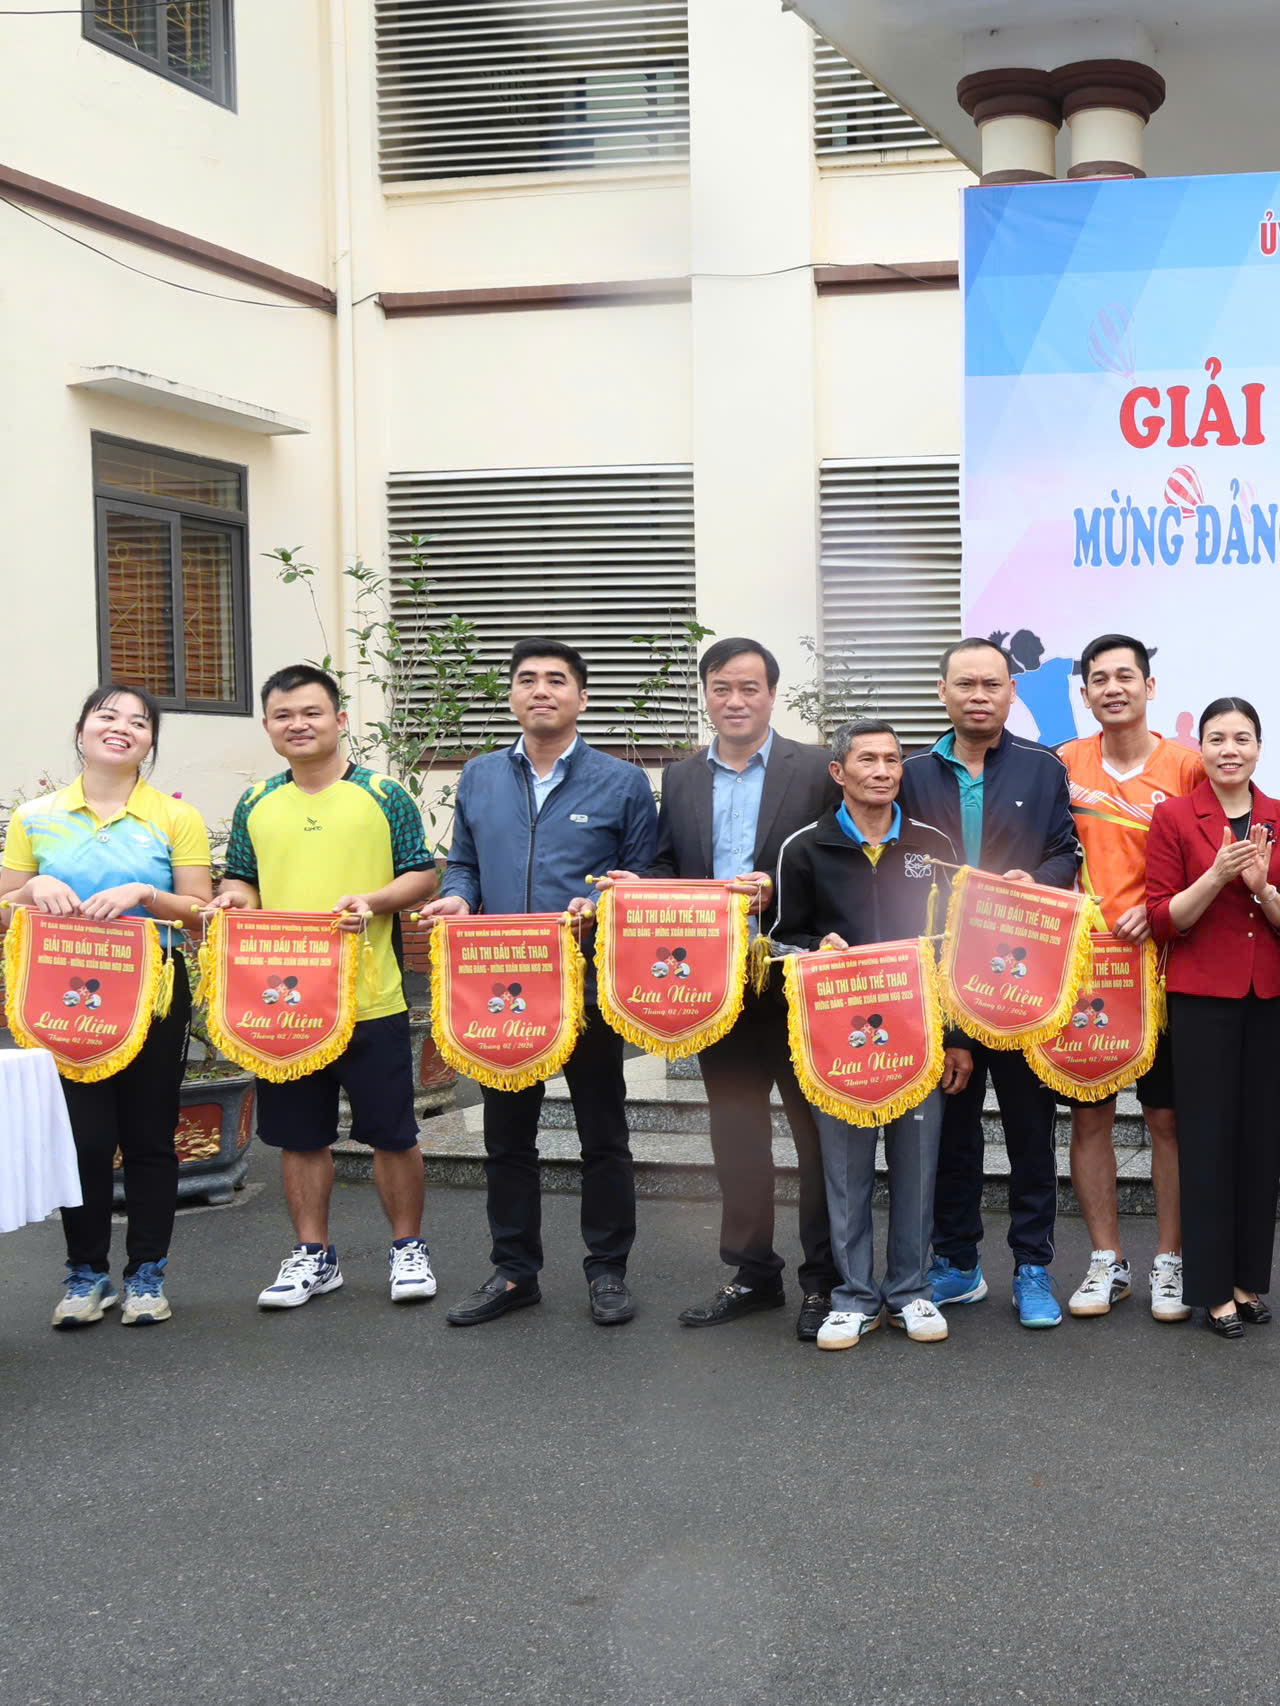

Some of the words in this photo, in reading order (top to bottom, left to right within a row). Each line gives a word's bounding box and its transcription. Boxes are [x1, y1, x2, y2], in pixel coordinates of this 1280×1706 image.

[1119, 357, 1265, 448] GIẢI
[1073, 488, 1184, 567] MỪNG
[627, 985, 662, 1003] Lưu
[668, 985, 712, 1006] Niệm
[962, 975, 996, 996] Lưu
[1000, 983, 1044, 1007] Niệm
[33, 1011, 70, 1030] Lưu
[74, 1014, 118, 1037] Niệm
[236, 1011, 272, 1028] Lưu
[277, 1011, 323, 1031] Niệm
[463, 1021, 497, 1038] Lưu
[503, 1020, 547, 1041] Niệm
[1052, 1034, 1083, 1052] Lưu
[1088, 1034, 1130, 1053] Niệm
[828, 1057, 863, 1077] Lưu
[868, 1052, 914, 1071] Niệm
